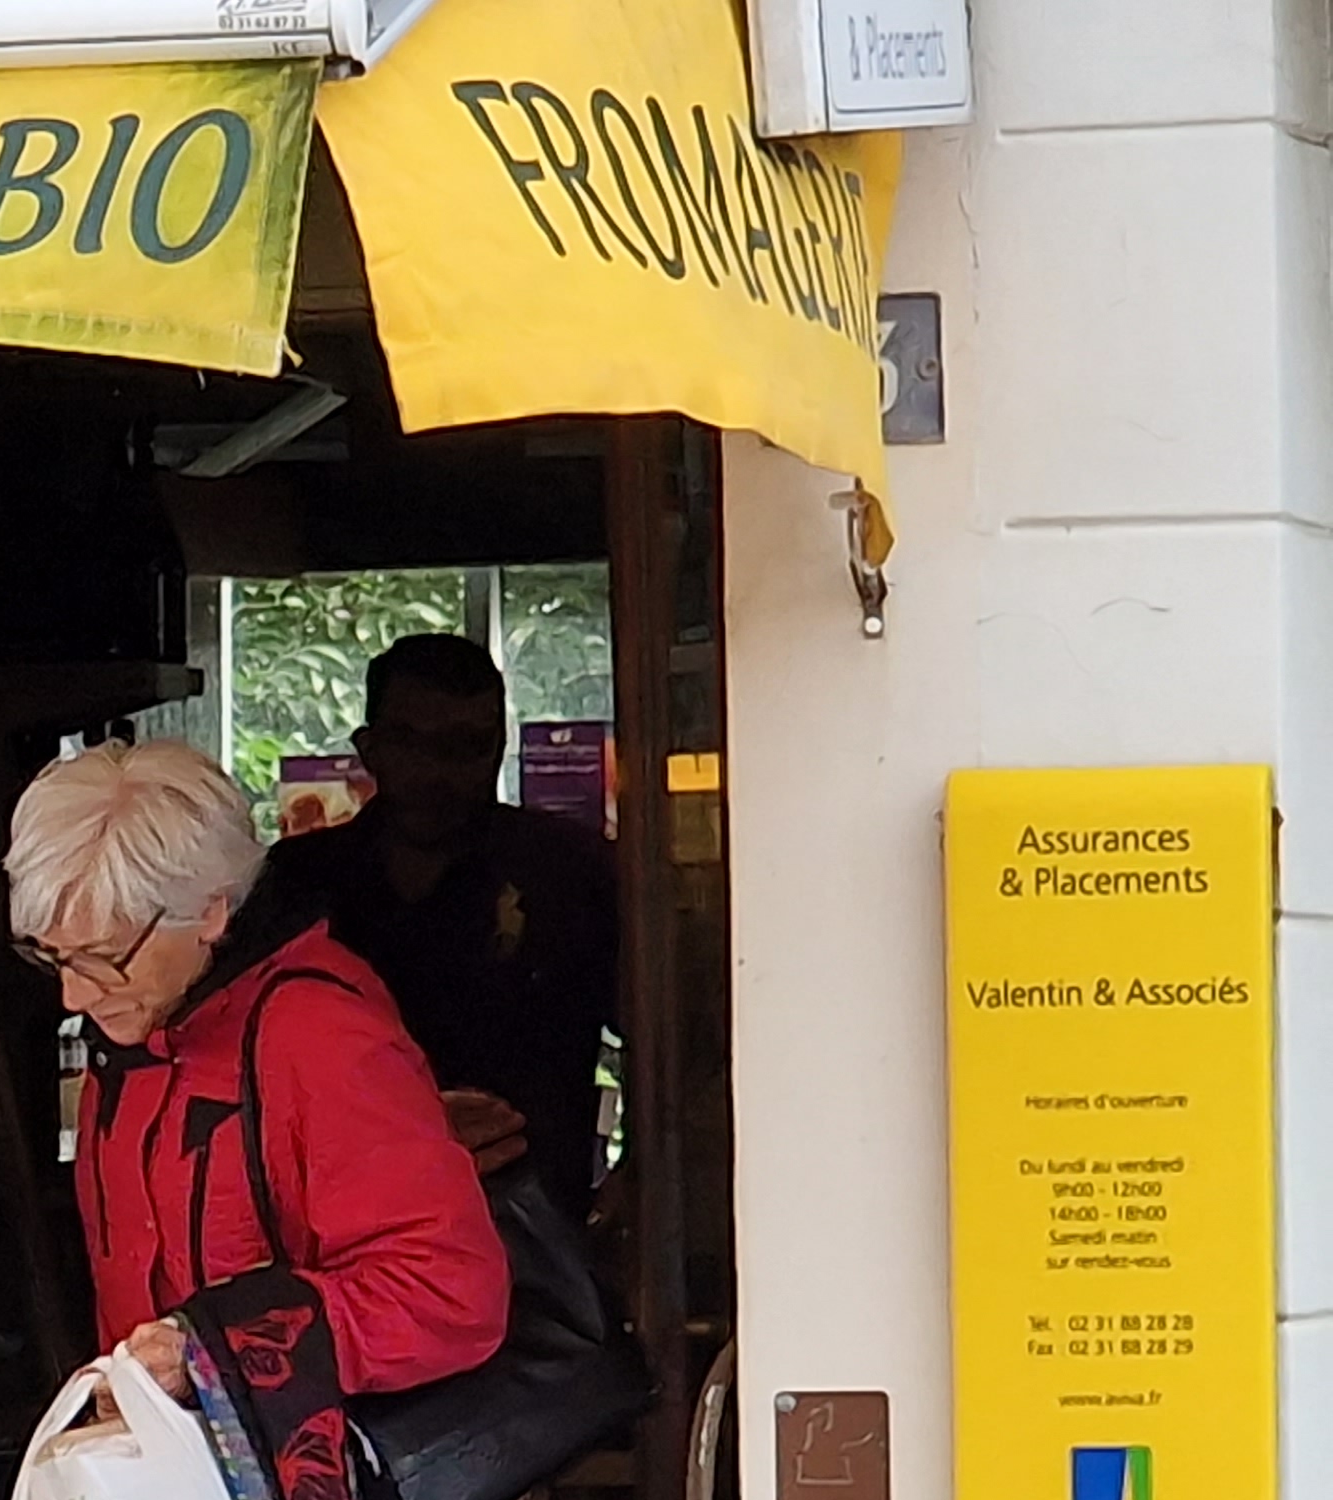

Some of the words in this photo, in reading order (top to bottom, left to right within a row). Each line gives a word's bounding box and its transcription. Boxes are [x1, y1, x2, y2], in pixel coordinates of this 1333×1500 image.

[1017, 825, 1191, 855] Assurances
[999, 867, 1024, 897] &
[1034, 865, 1209, 897] Placements
[966, 979, 1083, 1009] Valentin
[1093, 977, 1116, 1006] &
[1125, 976, 1250, 1006] Associés
[1019, 1159, 1044, 1176] Du
[1047, 1157, 1087, 1175] lundi
[1090, 1160, 1113, 1175] au
[1116, 1156, 1186, 1174] vendredi
[1052, 1181, 1095, 1199] 9h00
[1112, 1180, 1163, 1198] 12h00
[1049, 1204, 1100, 1222] 14h00
[1117, 1204, 1168, 1222] 18h00
[1048, 1229, 1107, 1246] Samedi
[1067, 1314, 1090, 1332] 02
[1095, 1314, 1114, 1332] 31
[1068, 1338, 1090, 1356] 02
[1095, 1338, 1114, 1356] 31
